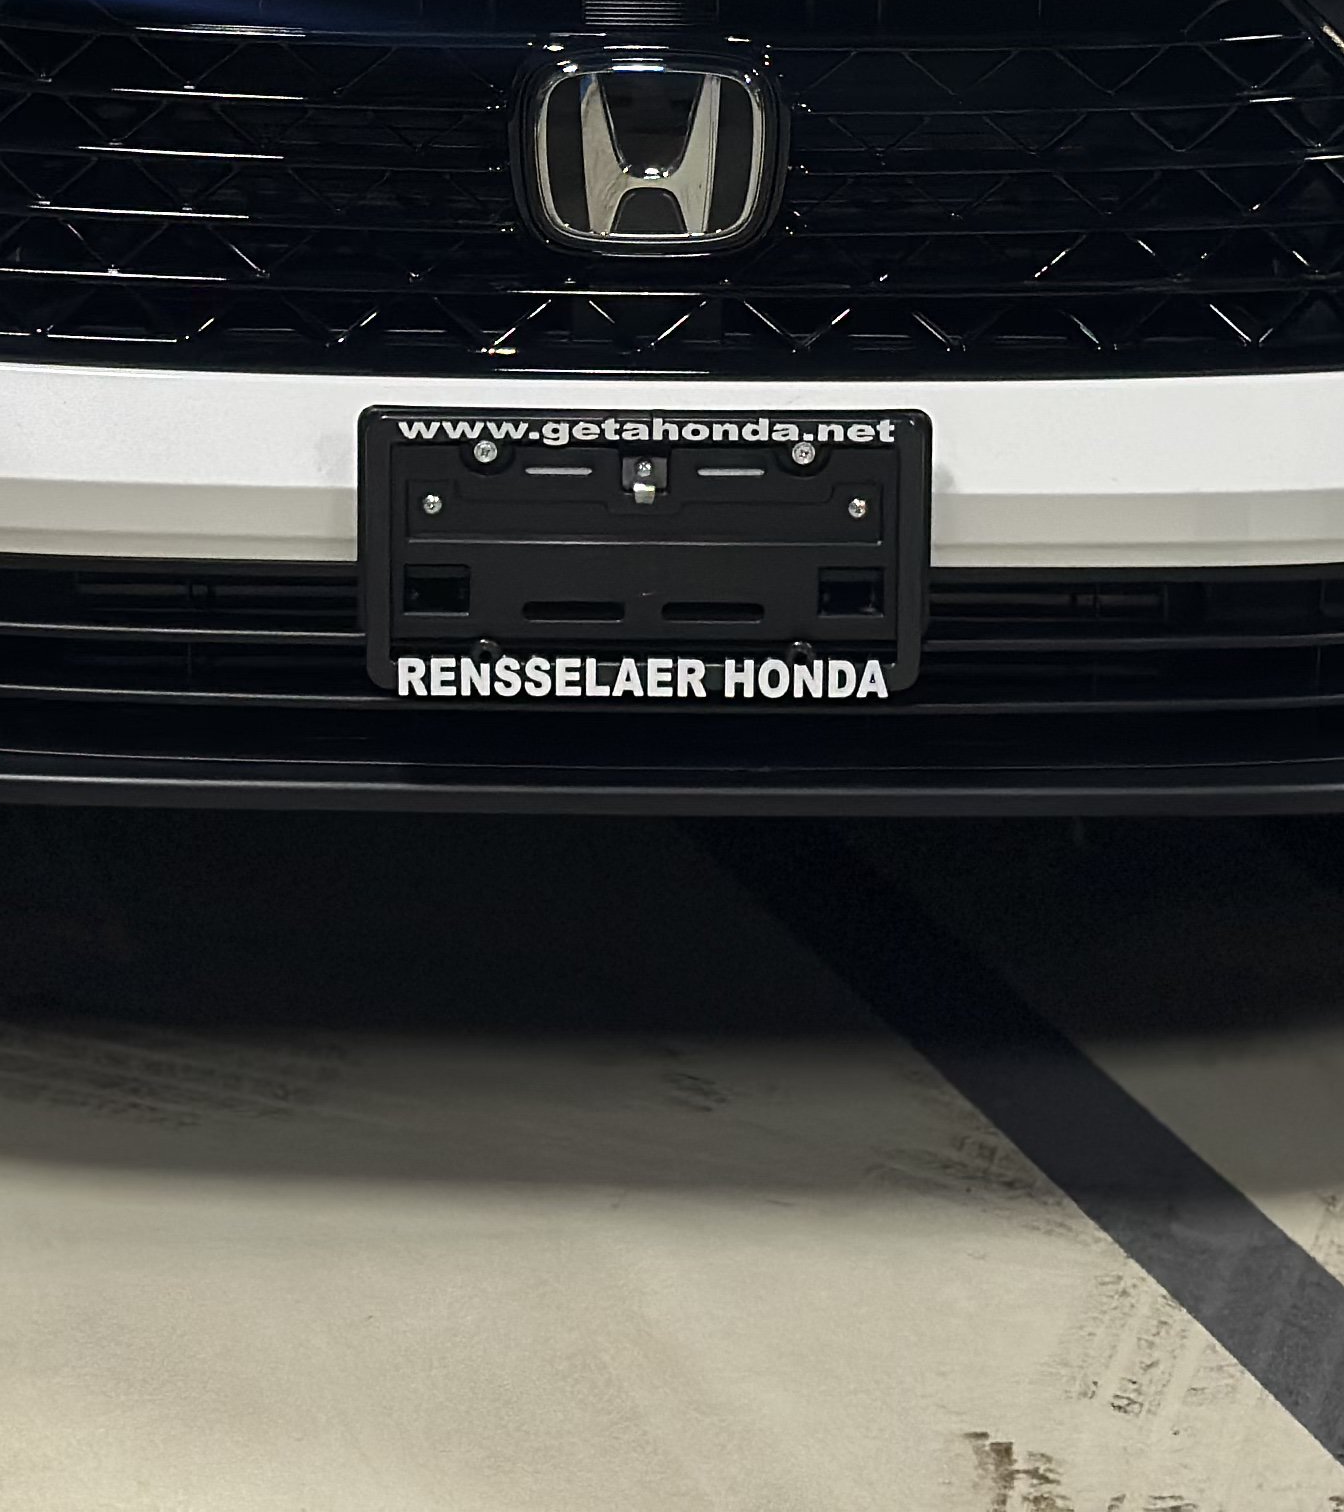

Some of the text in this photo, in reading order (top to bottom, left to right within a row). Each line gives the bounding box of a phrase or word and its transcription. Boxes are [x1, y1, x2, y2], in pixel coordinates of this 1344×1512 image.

[398, 419, 895, 444] www.getahonda.net
[397, 657, 889, 699] RENSSELAER HONDA
